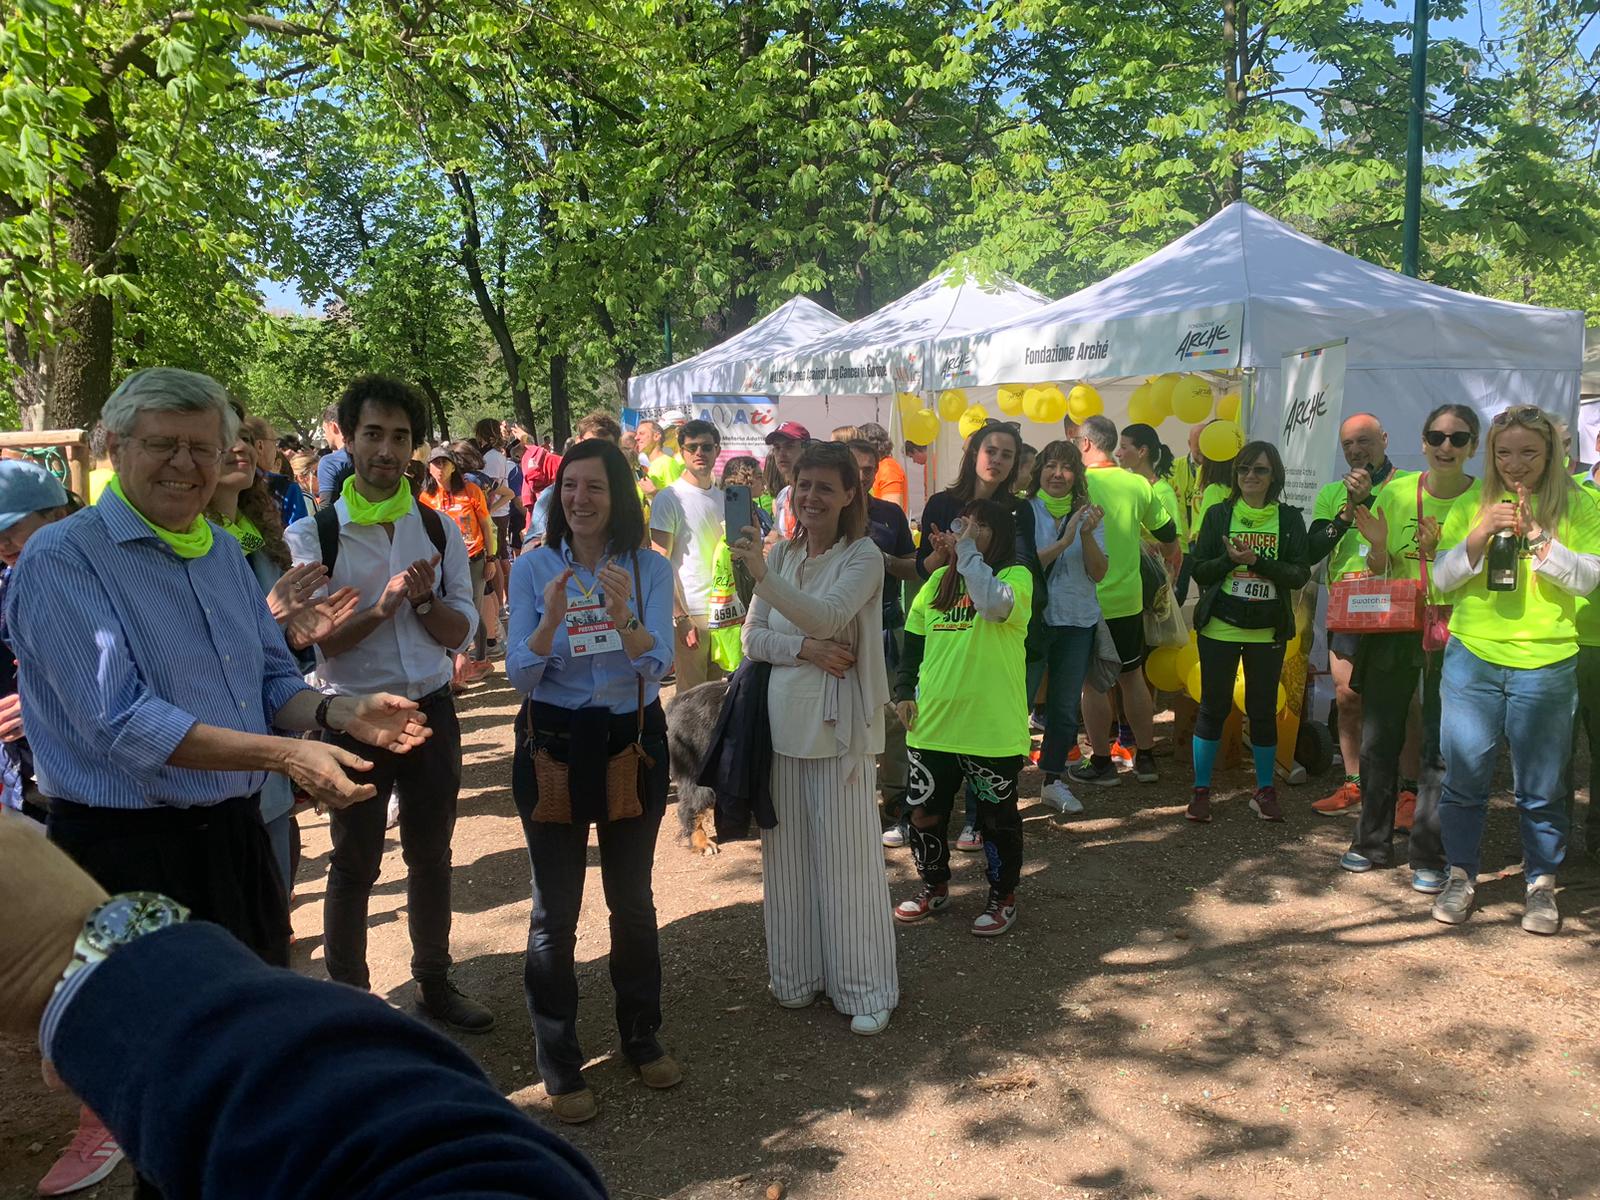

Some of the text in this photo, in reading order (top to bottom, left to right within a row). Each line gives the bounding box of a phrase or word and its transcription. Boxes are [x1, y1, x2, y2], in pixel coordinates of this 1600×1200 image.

[1025, 339, 1109, 365] Fondazione Arché
[839, 366, 859, 379] Cancer
[860, 364, 867, 378] in
[867, 364, 887, 378] Europe
[1244, 583, 1270, 599] 461A
[1352, 597, 1381, 605] swatch
[714, 606, 738, 621] 859A
